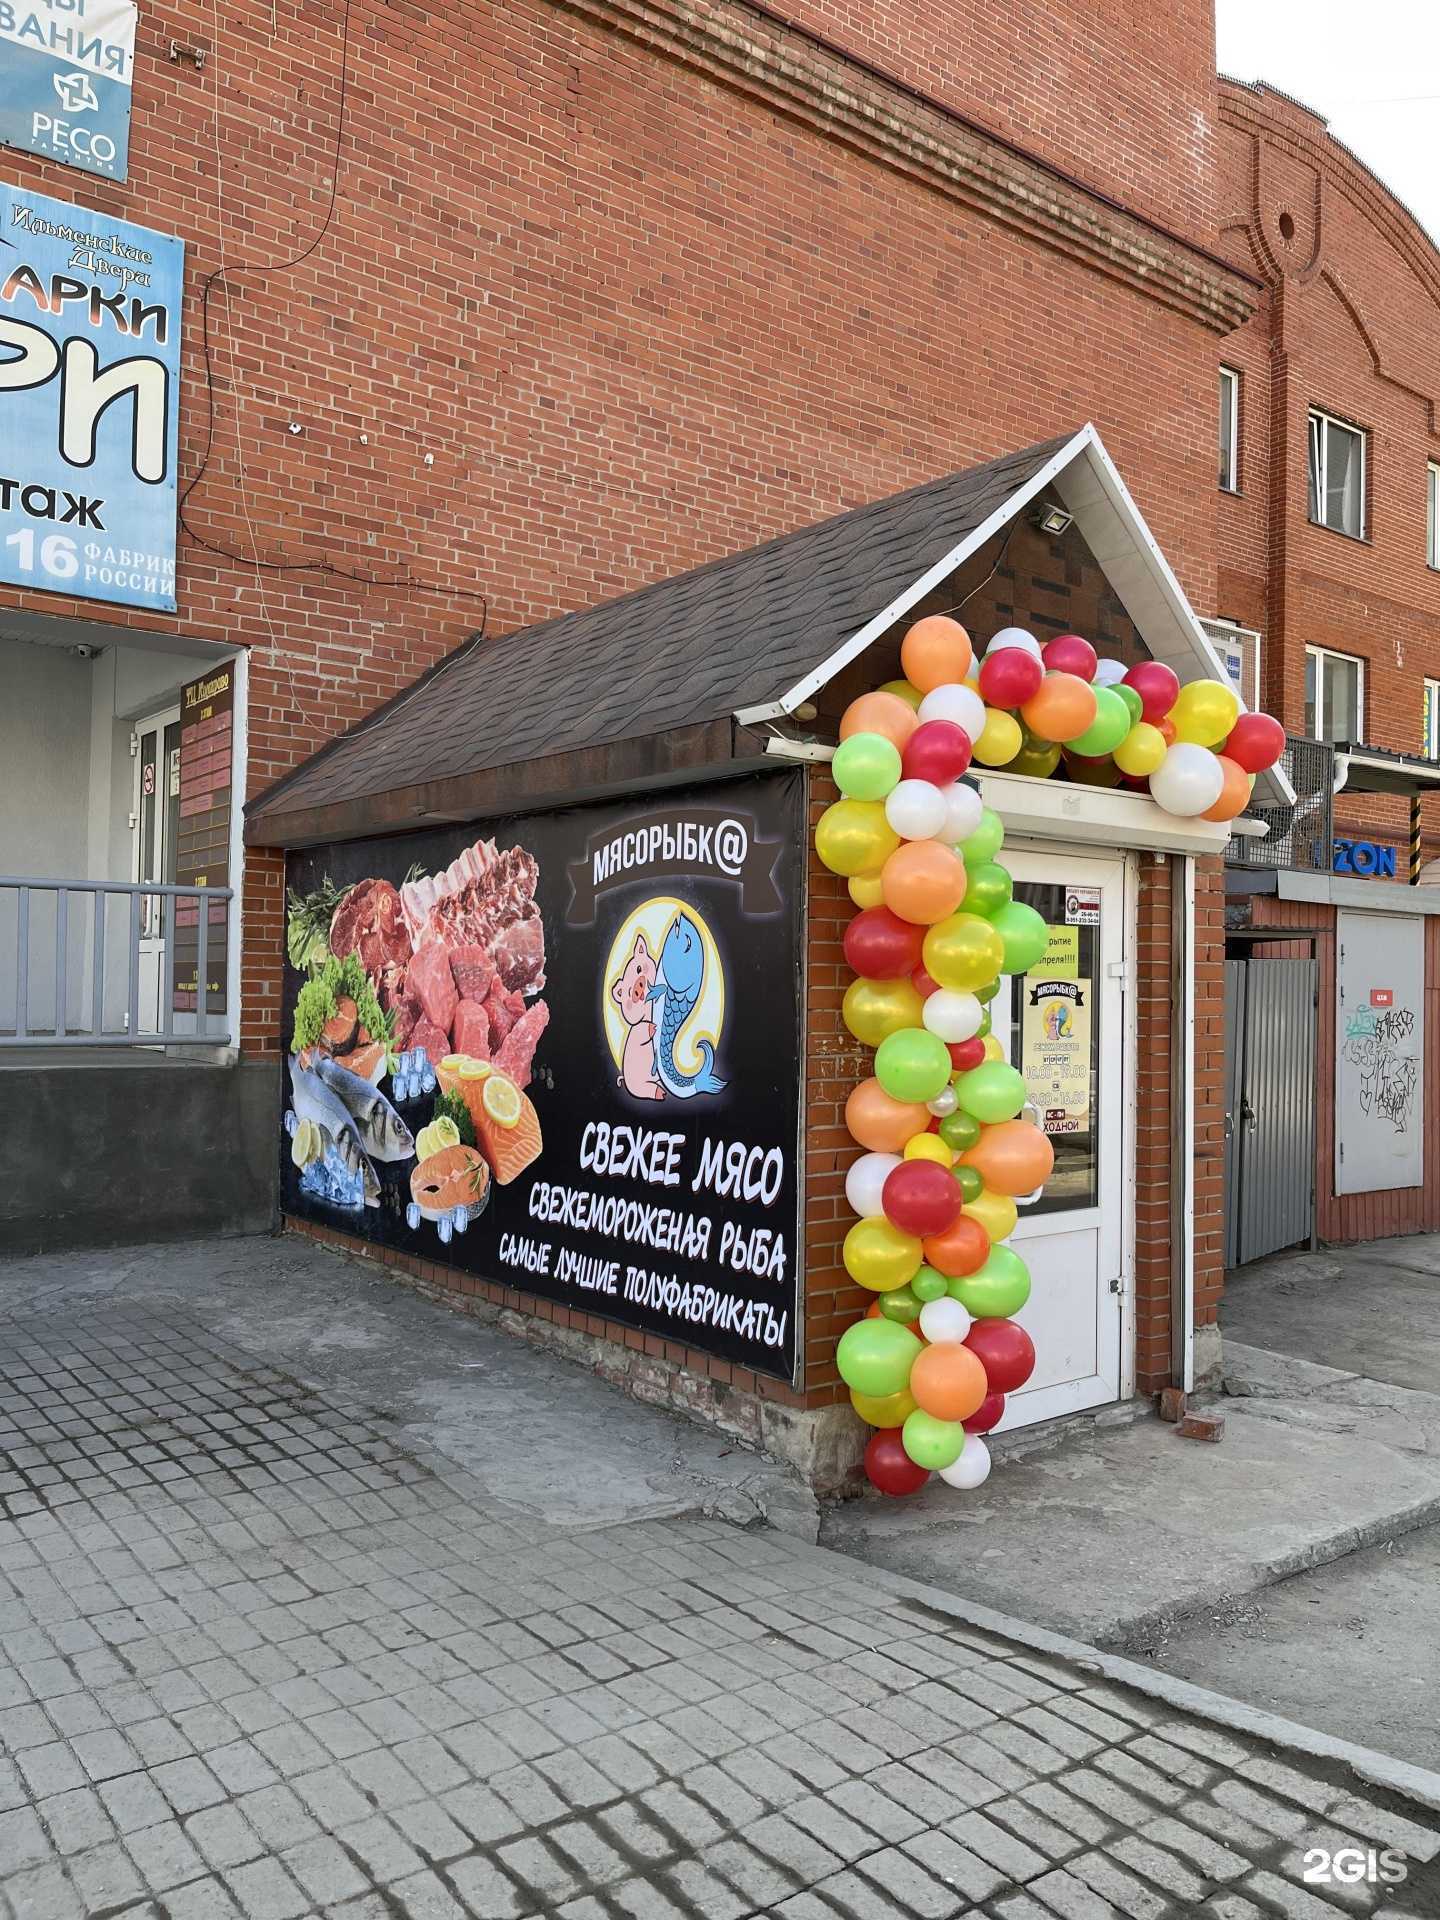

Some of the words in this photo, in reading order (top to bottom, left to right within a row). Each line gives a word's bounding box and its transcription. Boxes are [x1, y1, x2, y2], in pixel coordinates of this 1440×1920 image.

[32, 112, 116, 162] РЕСО
[11, 203, 152, 264] Ильменские
[68, 245, 151, 291] Двери
[6, 528, 79, 578] 16
[84, 542, 175, 576] ФАБРИК
[84, 564, 174, 597] РОССИИ
[593, 818, 748, 886] МЯСОРЫБК@
[579, 1121, 687, 1186] СВЕЖЕЕ
[691, 1136, 785, 1206] МЯСО
[528, 1181, 713, 1261] СВЕЖЕМОРОЖЕНАЯ
[718, 1220, 788, 1283] РЫБА
[499, 1232, 553, 1275] САМЫЕ
[553, 1246, 621, 1295] ЛУЧШИЕ
[623, 1265, 788, 1348] ПОЛУФАБРИКАТЫ
